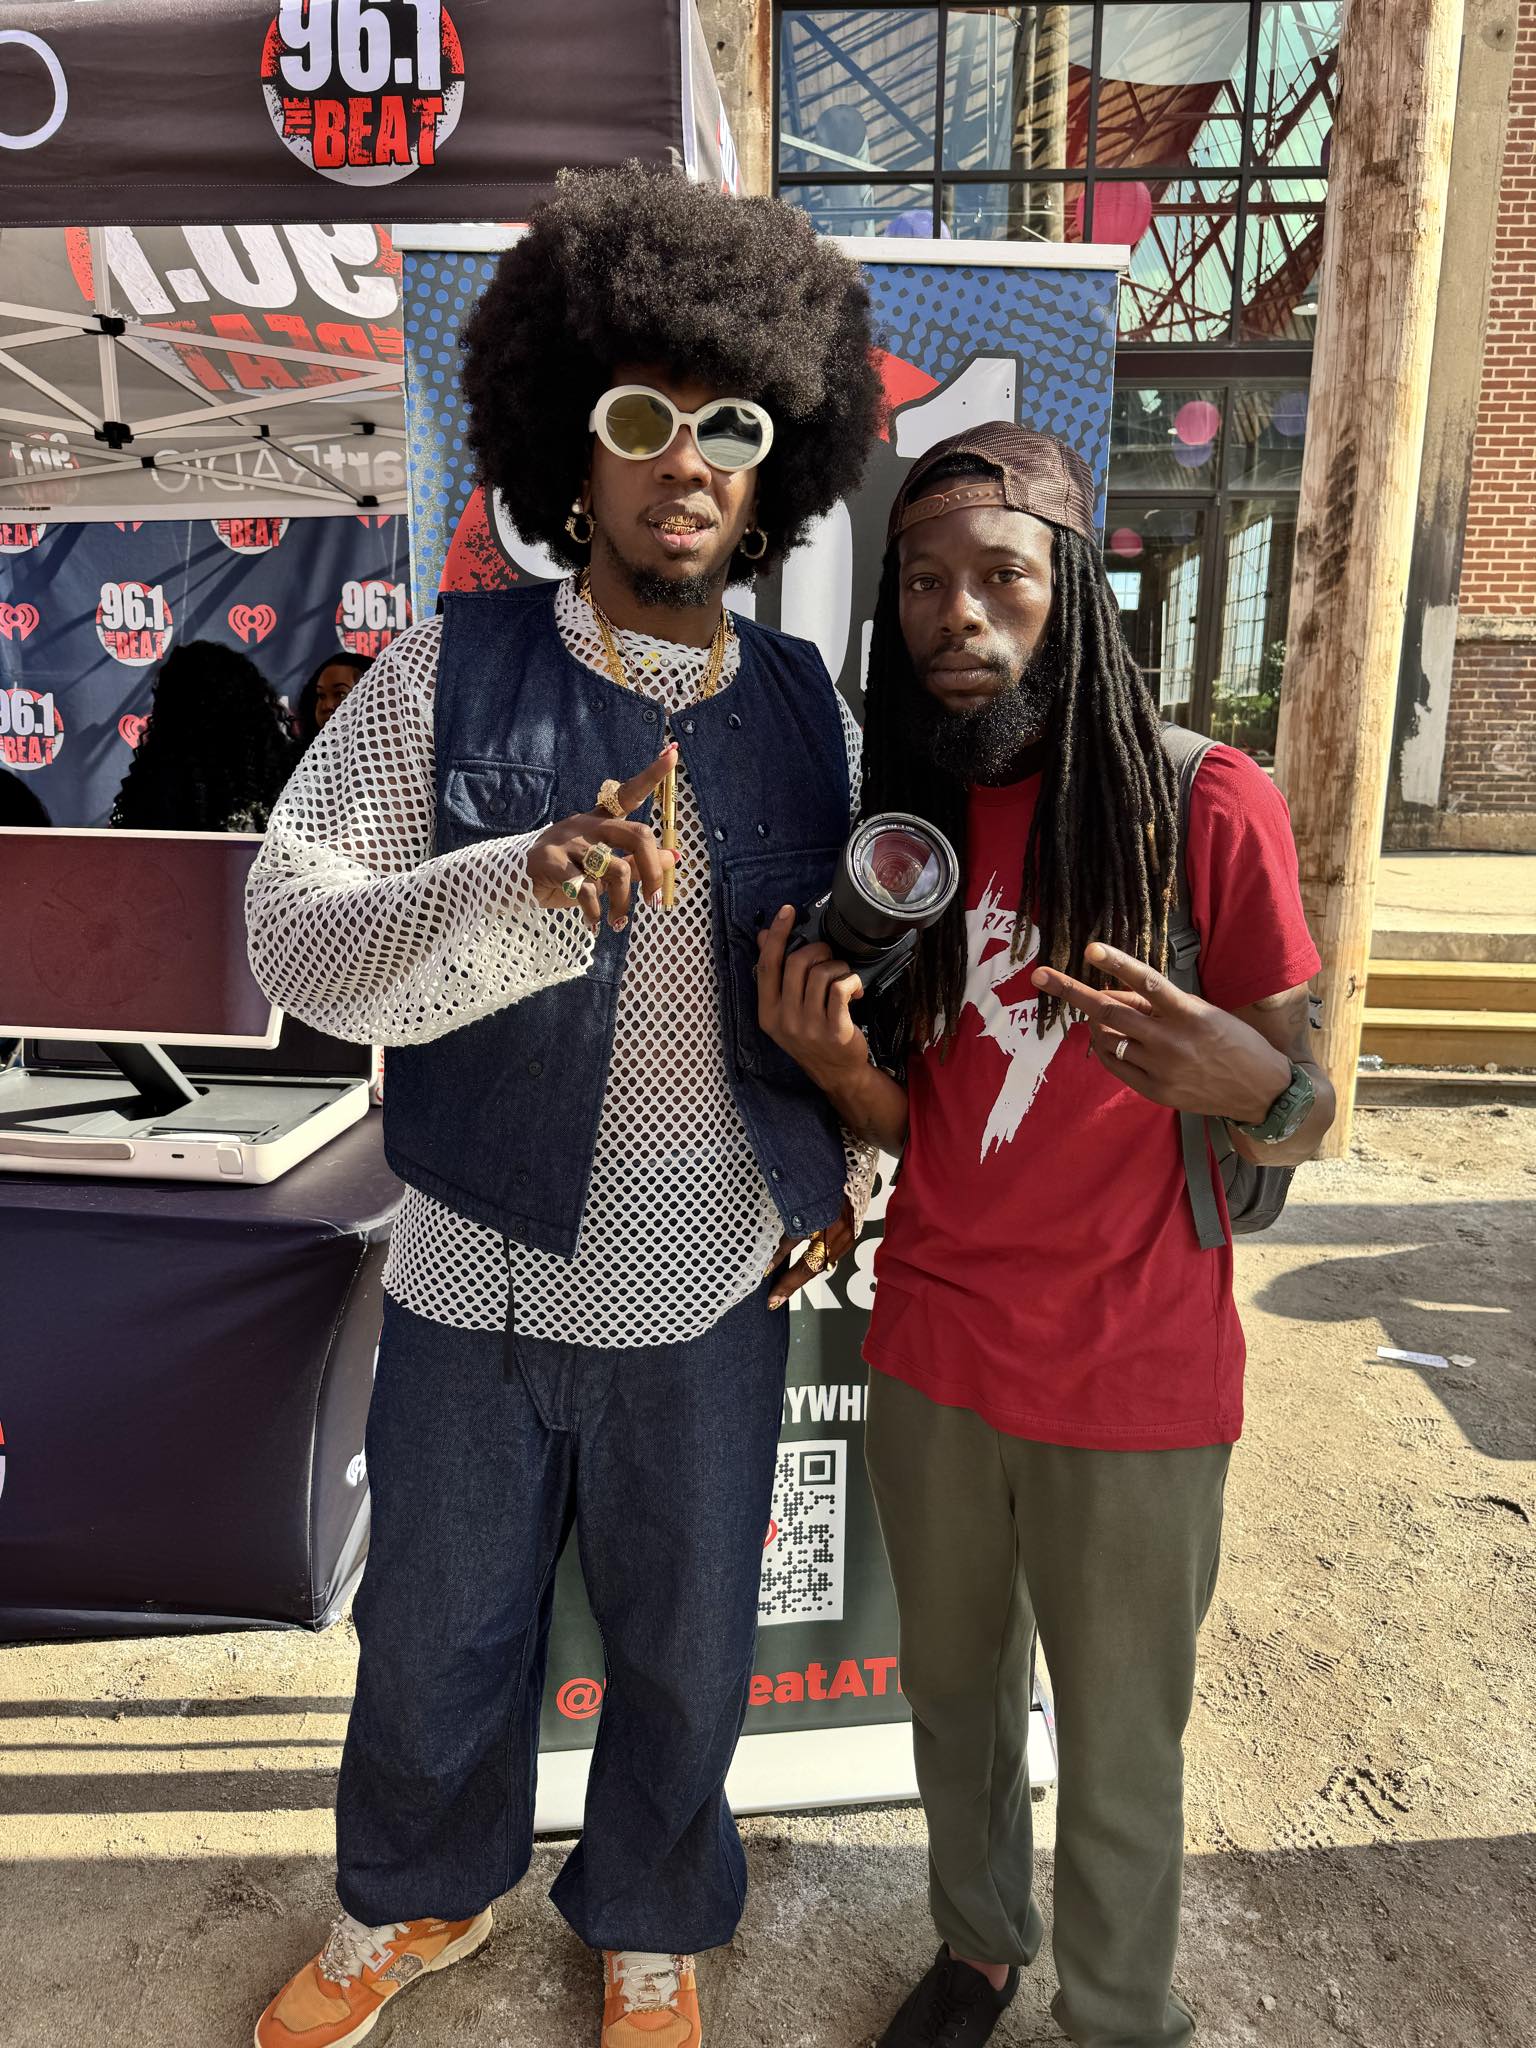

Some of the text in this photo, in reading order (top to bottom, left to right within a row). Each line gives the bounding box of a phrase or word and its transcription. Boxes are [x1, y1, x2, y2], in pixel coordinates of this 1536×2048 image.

[278, 0, 442, 92] 96.1
[283, 96, 445, 169] THE BEAT
[0, 523, 40, 547] EAT
[230, 518, 283, 548] BEAT
[100, 582, 165, 631] 96.1
[341, 580, 407, 631] 96.1
[115, 630, 166, 660] BEAT
[355, 630, 400, 658] BEA
[3, 735, 55, 766] BEAT
[981, 912, 1028, 934] RIS
[781, 1384, 868, 1425] YWH
